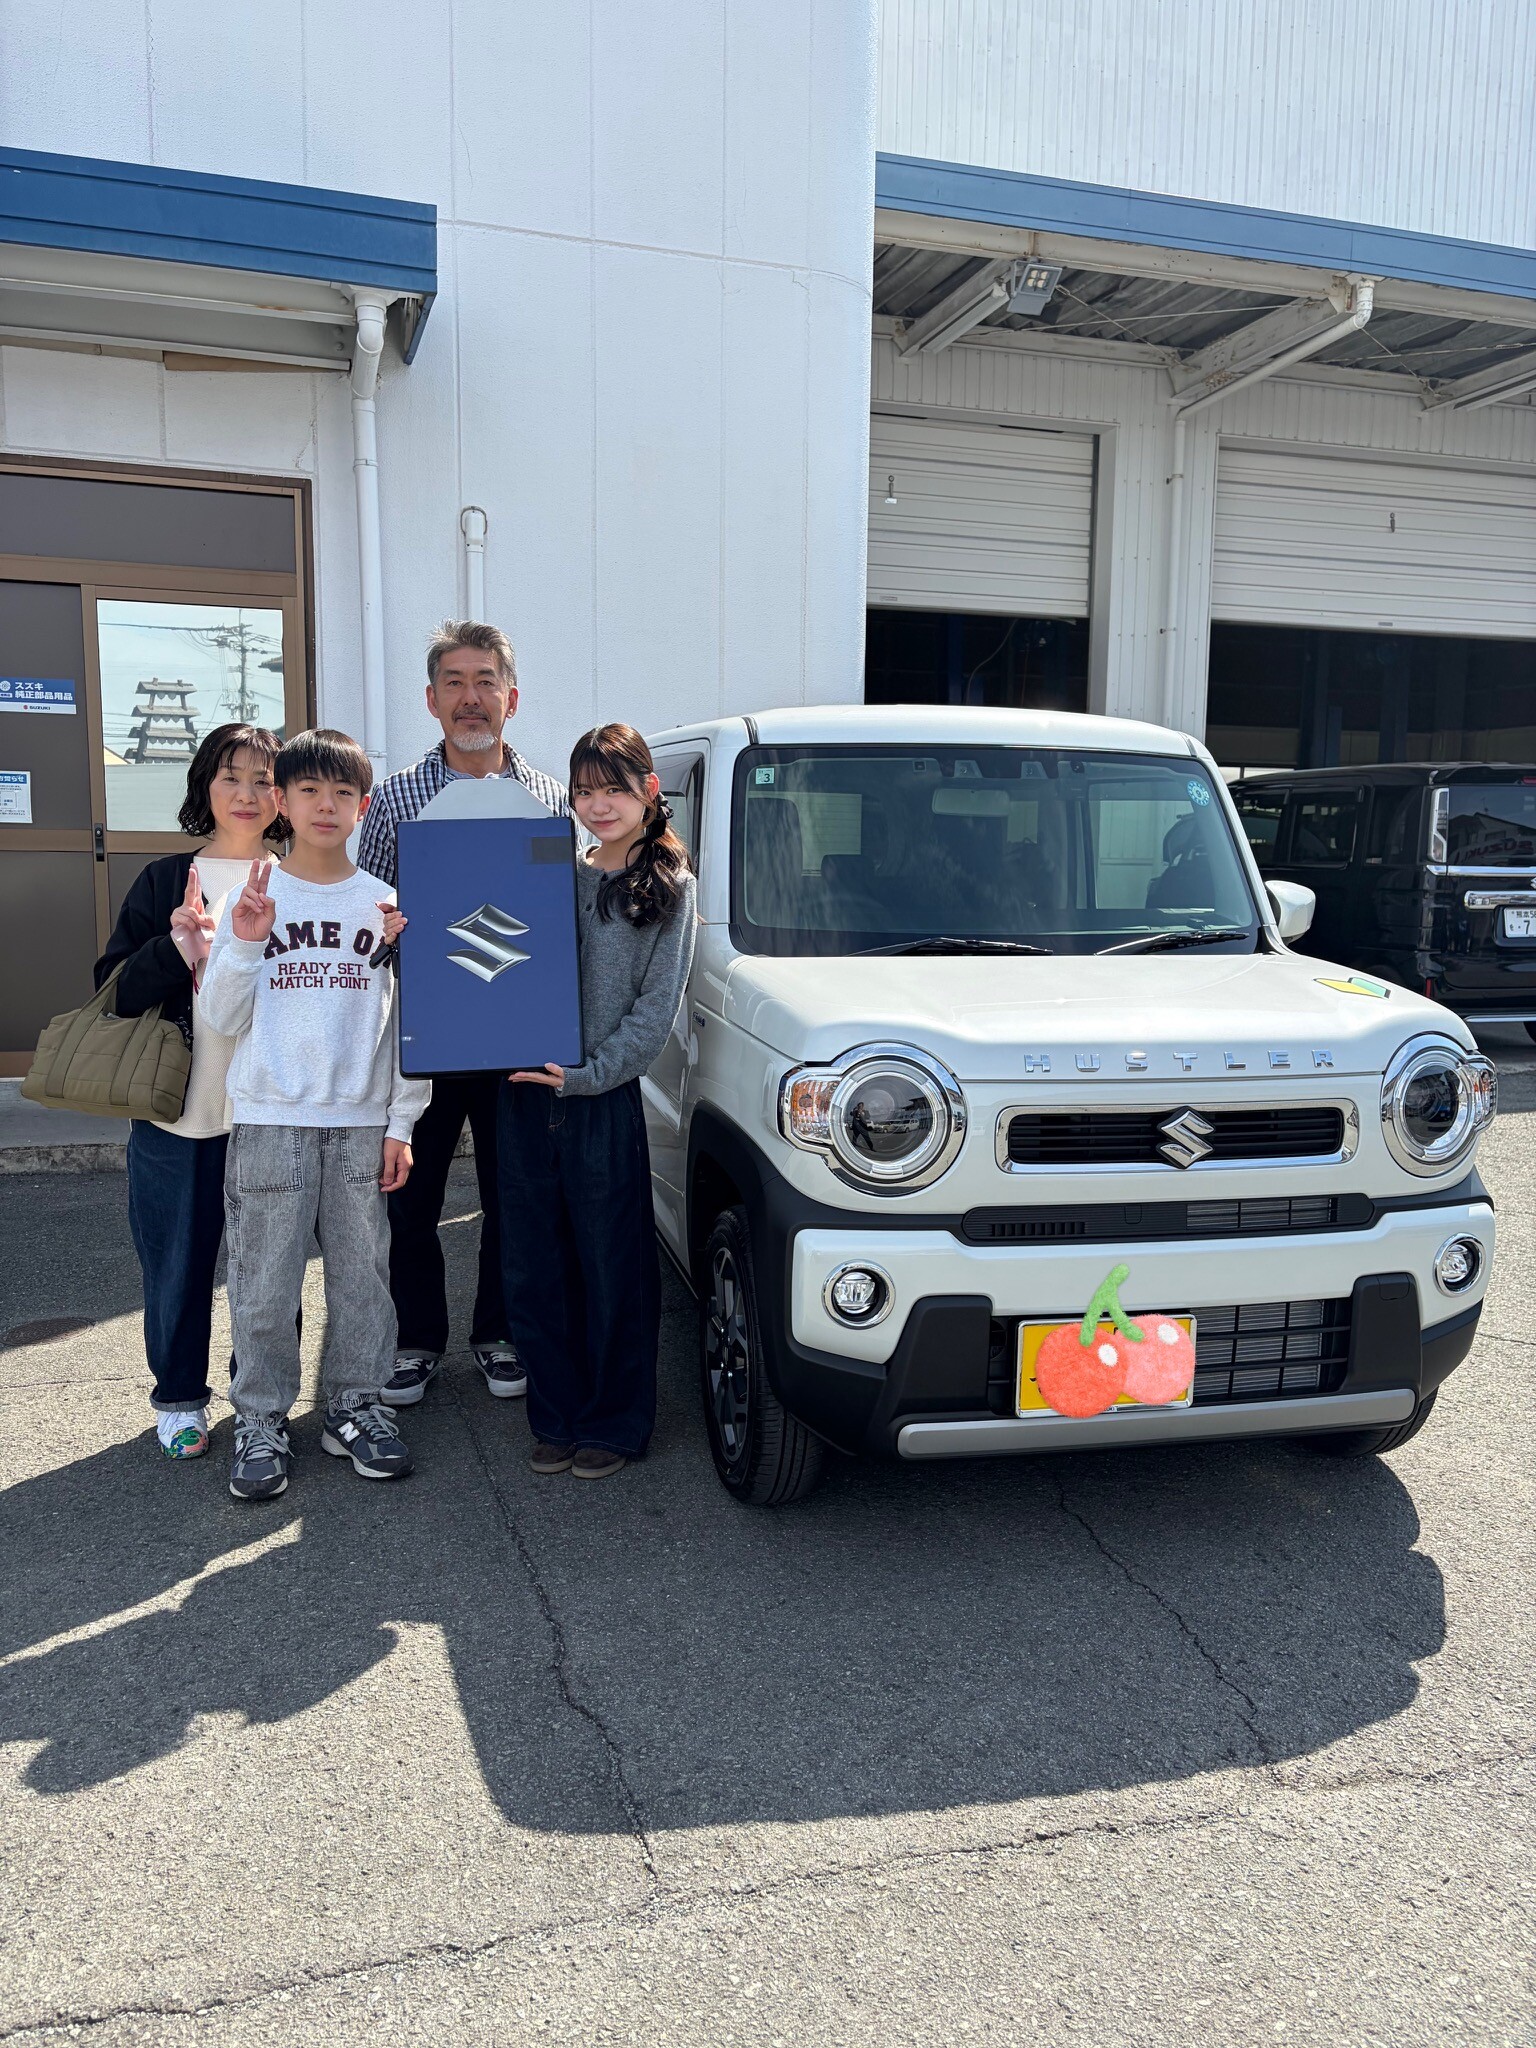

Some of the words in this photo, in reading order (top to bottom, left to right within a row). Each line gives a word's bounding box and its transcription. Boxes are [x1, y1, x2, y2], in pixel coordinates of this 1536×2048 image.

[15, 682, 43, 690] スズキ
[15, 690, 73, 700] 純正部品用品
[263, 921, 341, 960] AME
[278, 962, 332, 975] READY
[338, 963, 363, 975] SET
[270, 976, 324, 990] MATCH
[329, 977, 370, 990] POINT
[1024, 1049, 1335, 1073] HUSTLER
